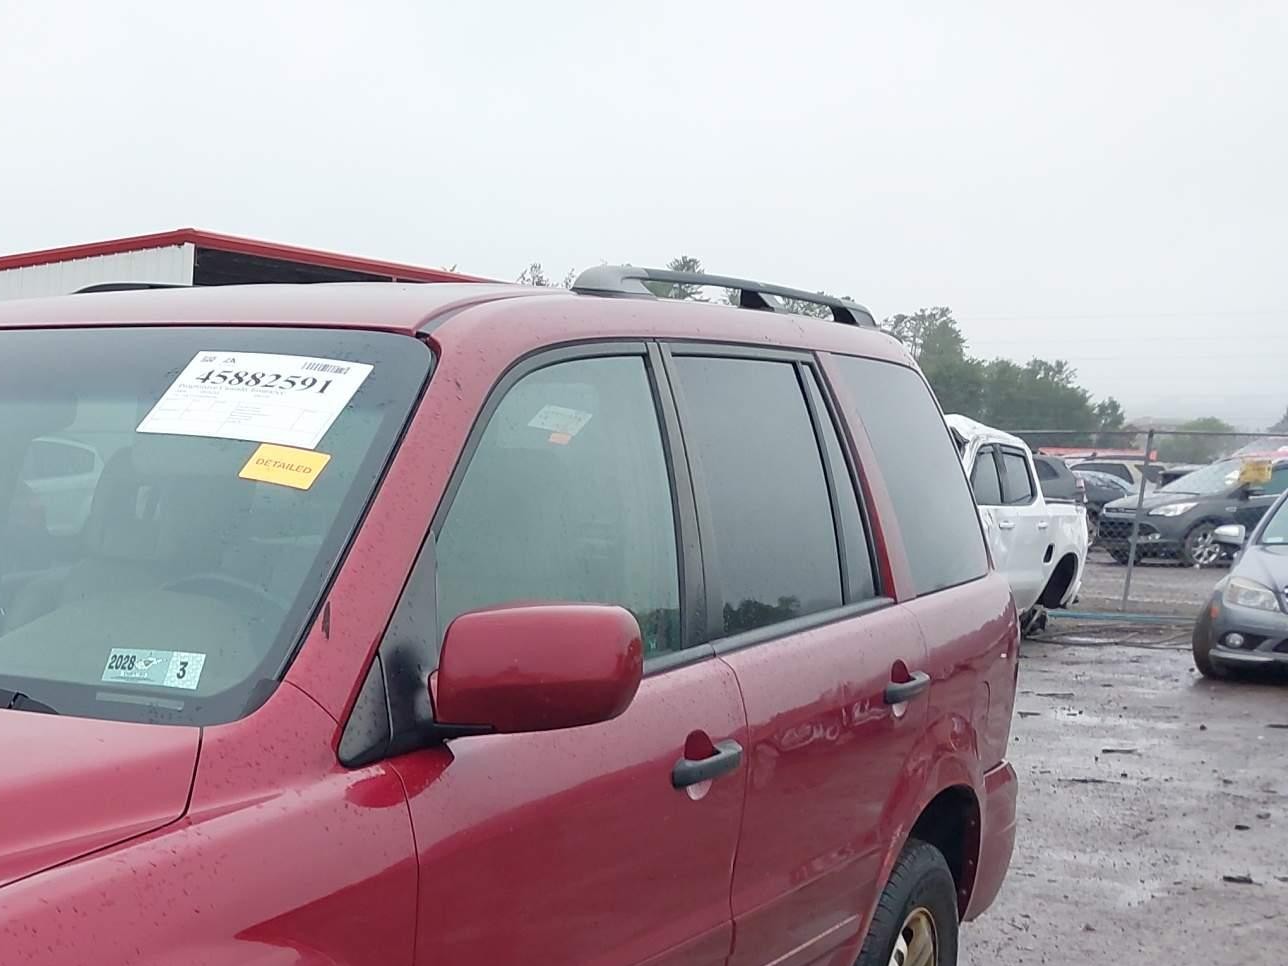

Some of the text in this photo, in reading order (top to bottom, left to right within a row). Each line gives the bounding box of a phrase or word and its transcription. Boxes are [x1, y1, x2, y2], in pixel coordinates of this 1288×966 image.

[195, 369, 333, 394] 45882591
[256, 458, 313, 474] DETAILED
[108, 654, 137, 670] 2028
[176, 660, 189, 679] 3
